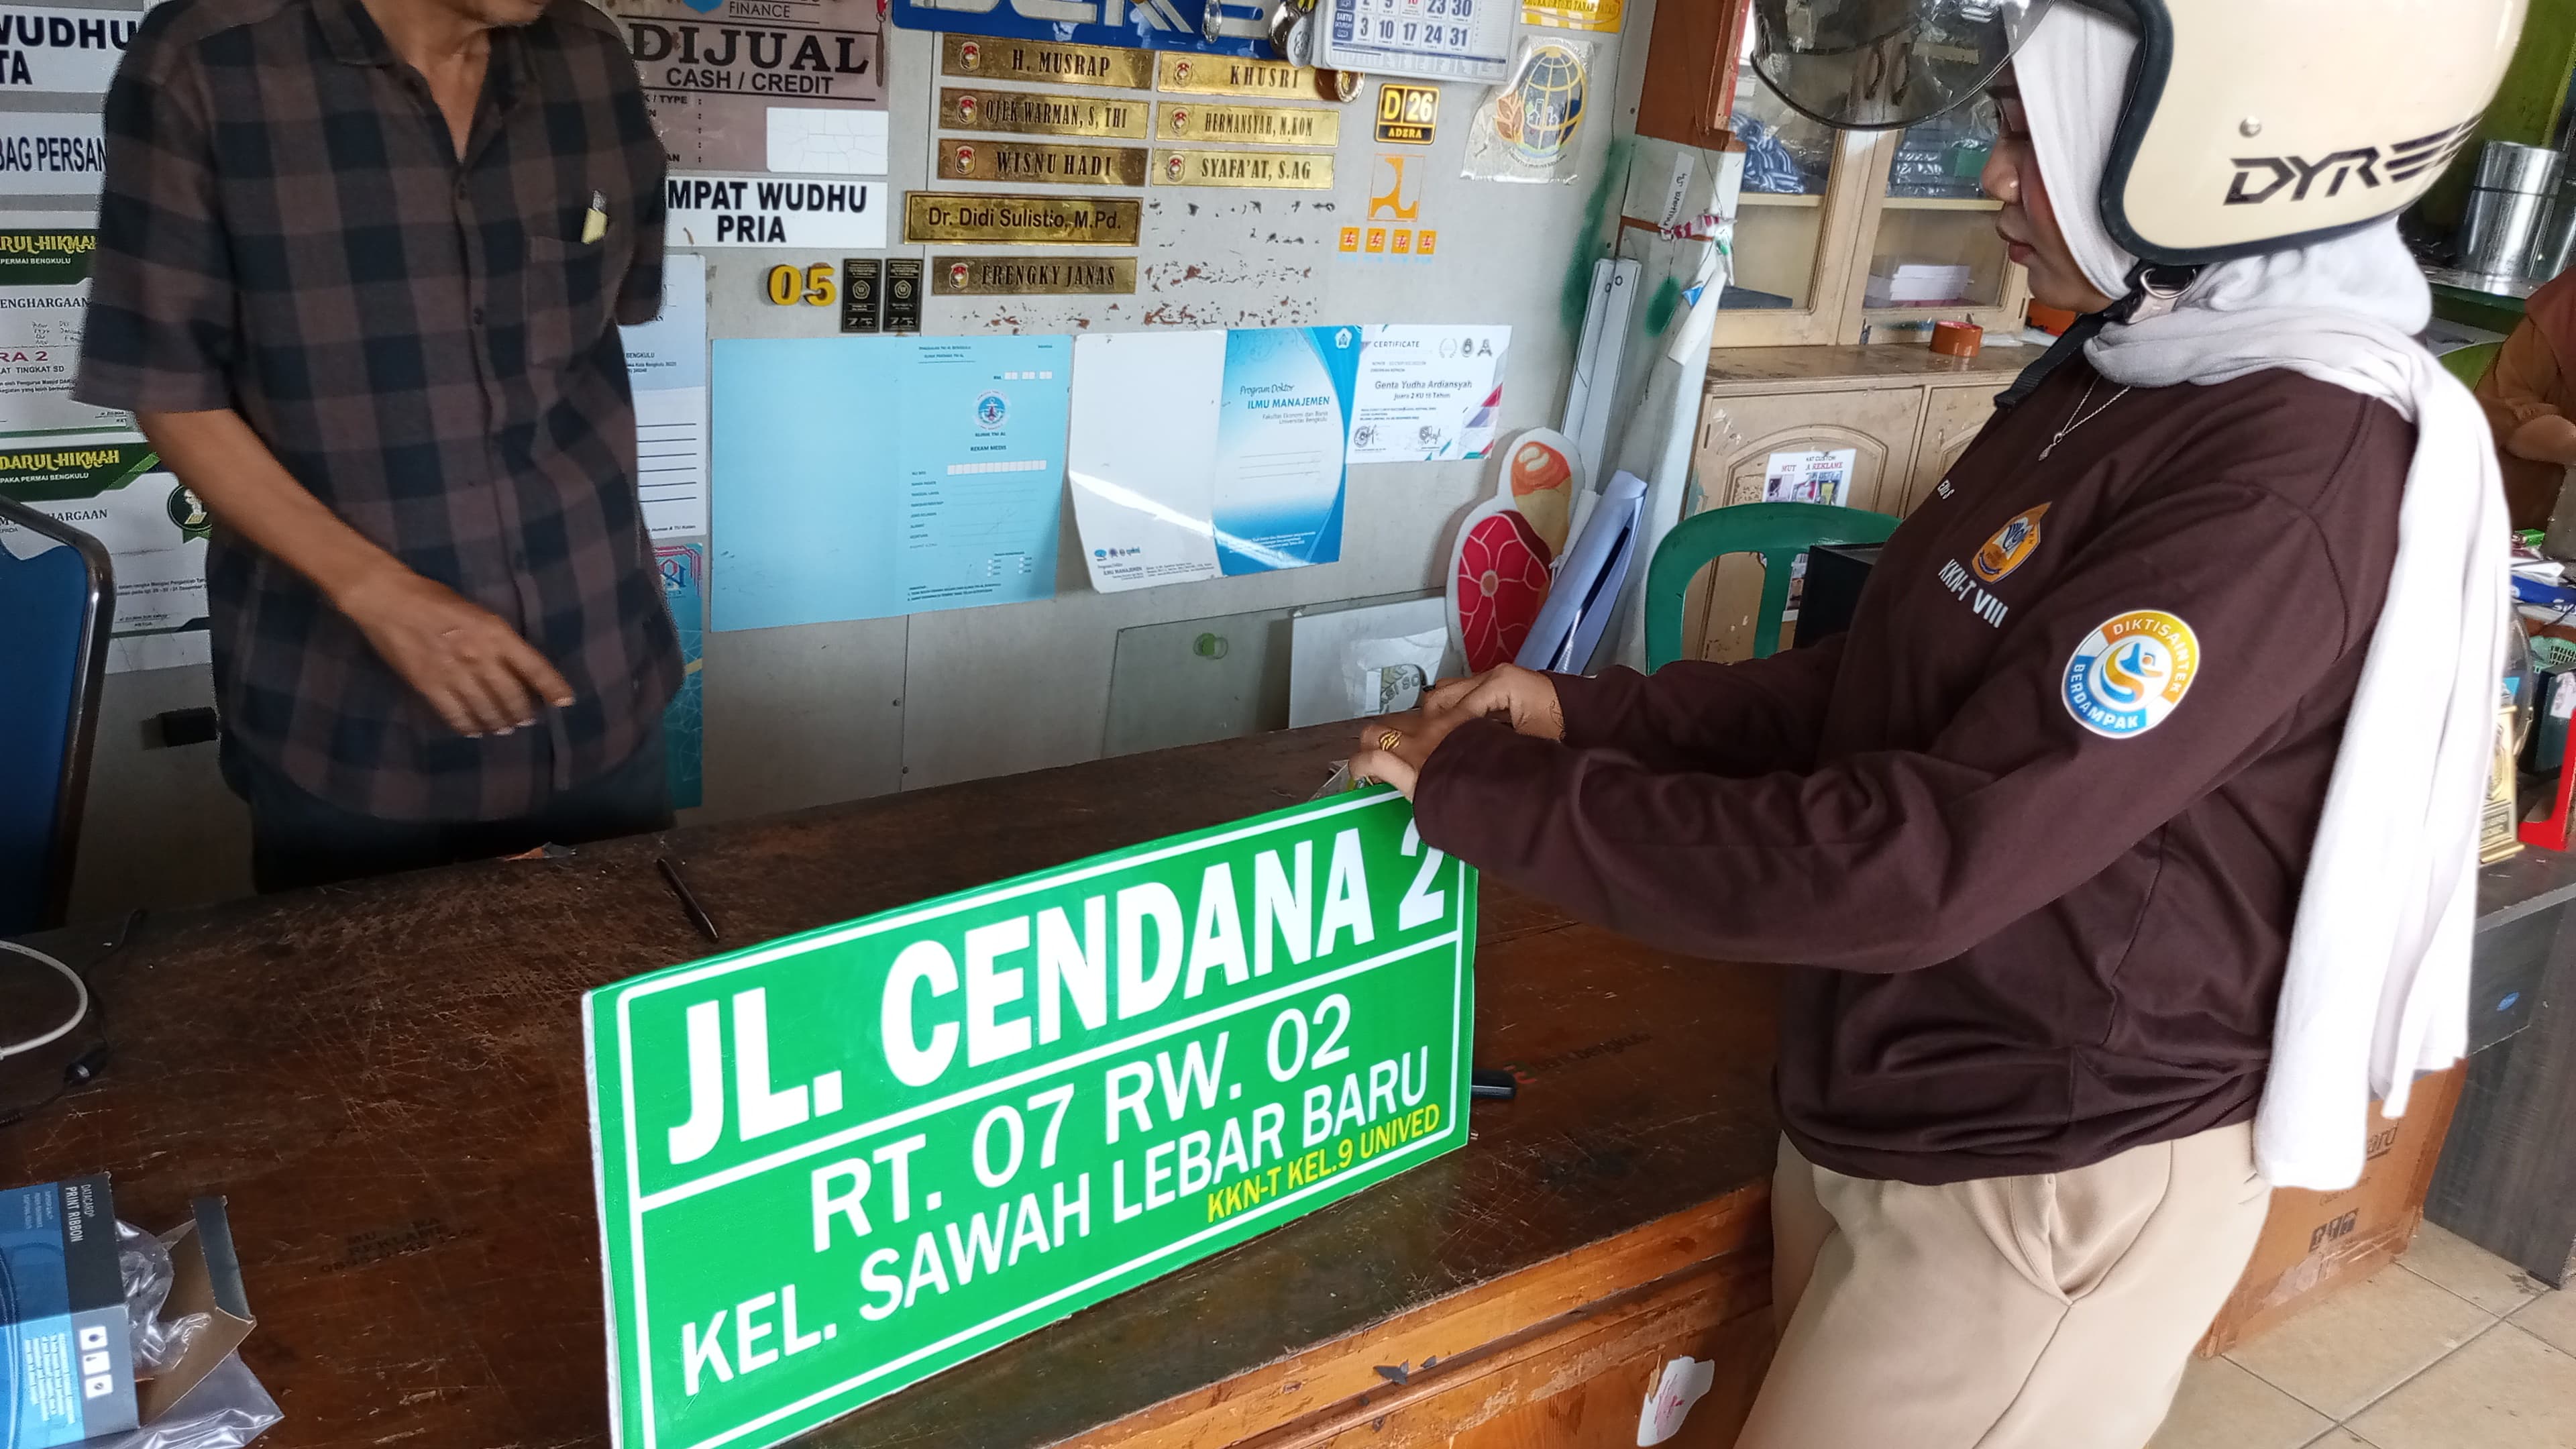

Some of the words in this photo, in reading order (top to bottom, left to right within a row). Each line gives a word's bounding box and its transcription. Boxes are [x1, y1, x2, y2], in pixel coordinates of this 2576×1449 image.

[729, 1, 791, 18] FINANCE
[1452, 0, 1472, 17] 30
[1360, 17, 1368, 36] 3
[1379, 20, 1395, 39] 10
[1403, 22, 1417, 41] 17
[1424, 25, 1442, 44] 24
[1450, 27, 1468, 46] 31
[628, 23, 869, 74] DIJUAL
[1012, 49, 1030, 71] H.
[1040, 51, 1111, 77] MUSRAP
[666, 67, 731, 89] CASH
[751, 72, 834, 95] CREDIT
[1230, 66, 1299, 89] KHUSRI
[659, 95, 688, 104] TYPE
[1383, 89, 1401, 121] D
[1407, 91, 1434, 123] 26
[1024, 102, 1083, 129] WARMAN,
[1105, 107, 1128, 129] THI
[1205, 113, 1276, 136] HERMANSYAH,
[1279, 117, 1313, 136] M.KOM
[996, 151, 1057, 174] WISNU
[1063, 154, 1112, 176] HADI
[1278, 160, 1311, 180] S.AG
[757, 181, 867, 213] WUDHU
[717, 215, 787, 242] PRIA
[928, 207, 953, 226] Dr.
[959, 208, 994, 227] Didi
[1074, 211, 1121, 229] M.Pd.
[767, 261, 837, 307] 05
[981, 264, 1061, 286] FRENGKY
[1065, 266, 1116, 287] JANAS
[16, 366, 51, 374] TINGKAT
[53, 365, 65, 373] SD
[35, 352, 49, 362] 2
[1375, 380, 1399, 390] Genta
[1248, 399, 1269, 410] ILMU
[1272, 396, 1330, 409] MANAJEMEN
[50, 472, 89, 481] BENGKULU
[1937, 558, 1977, 602] KKN-T
[1972, 588, 2009, 629] VIII
[2112, 619, 2190, 693] DIKTISAINTEK
[2070, 663, 2139, 729] BERDAMPAK
[668, 987, 843, 1164] JL.
[880, 828, 1375, 1087] CENDANA
[1397, 816, 1446, 930] 2
[812, 1135, 941, 1252] RT.
[973, 1085, 1074, 1187] 07
[1106, 1032, 1242, 1144] RW.
[1267, 994, 1352, 1082] 02
[1207, 1166, 1282, 1224] KKN-T
[1287, 1138, 1354, 1190] KEL.9
[1360, 1103, 1440, 1159] UNIVED
[65, 1185, 79, 1210] PRINT
[68, 1210, 84, 1242] RIBBON
[683, 1284, 838, 1397] KEL.
[860, 1172, 1089, 1322] SAWAH
[1114, 1104, 1285, 1225] LEBAR
[1301, 1045, 1430, 1149] BARU
